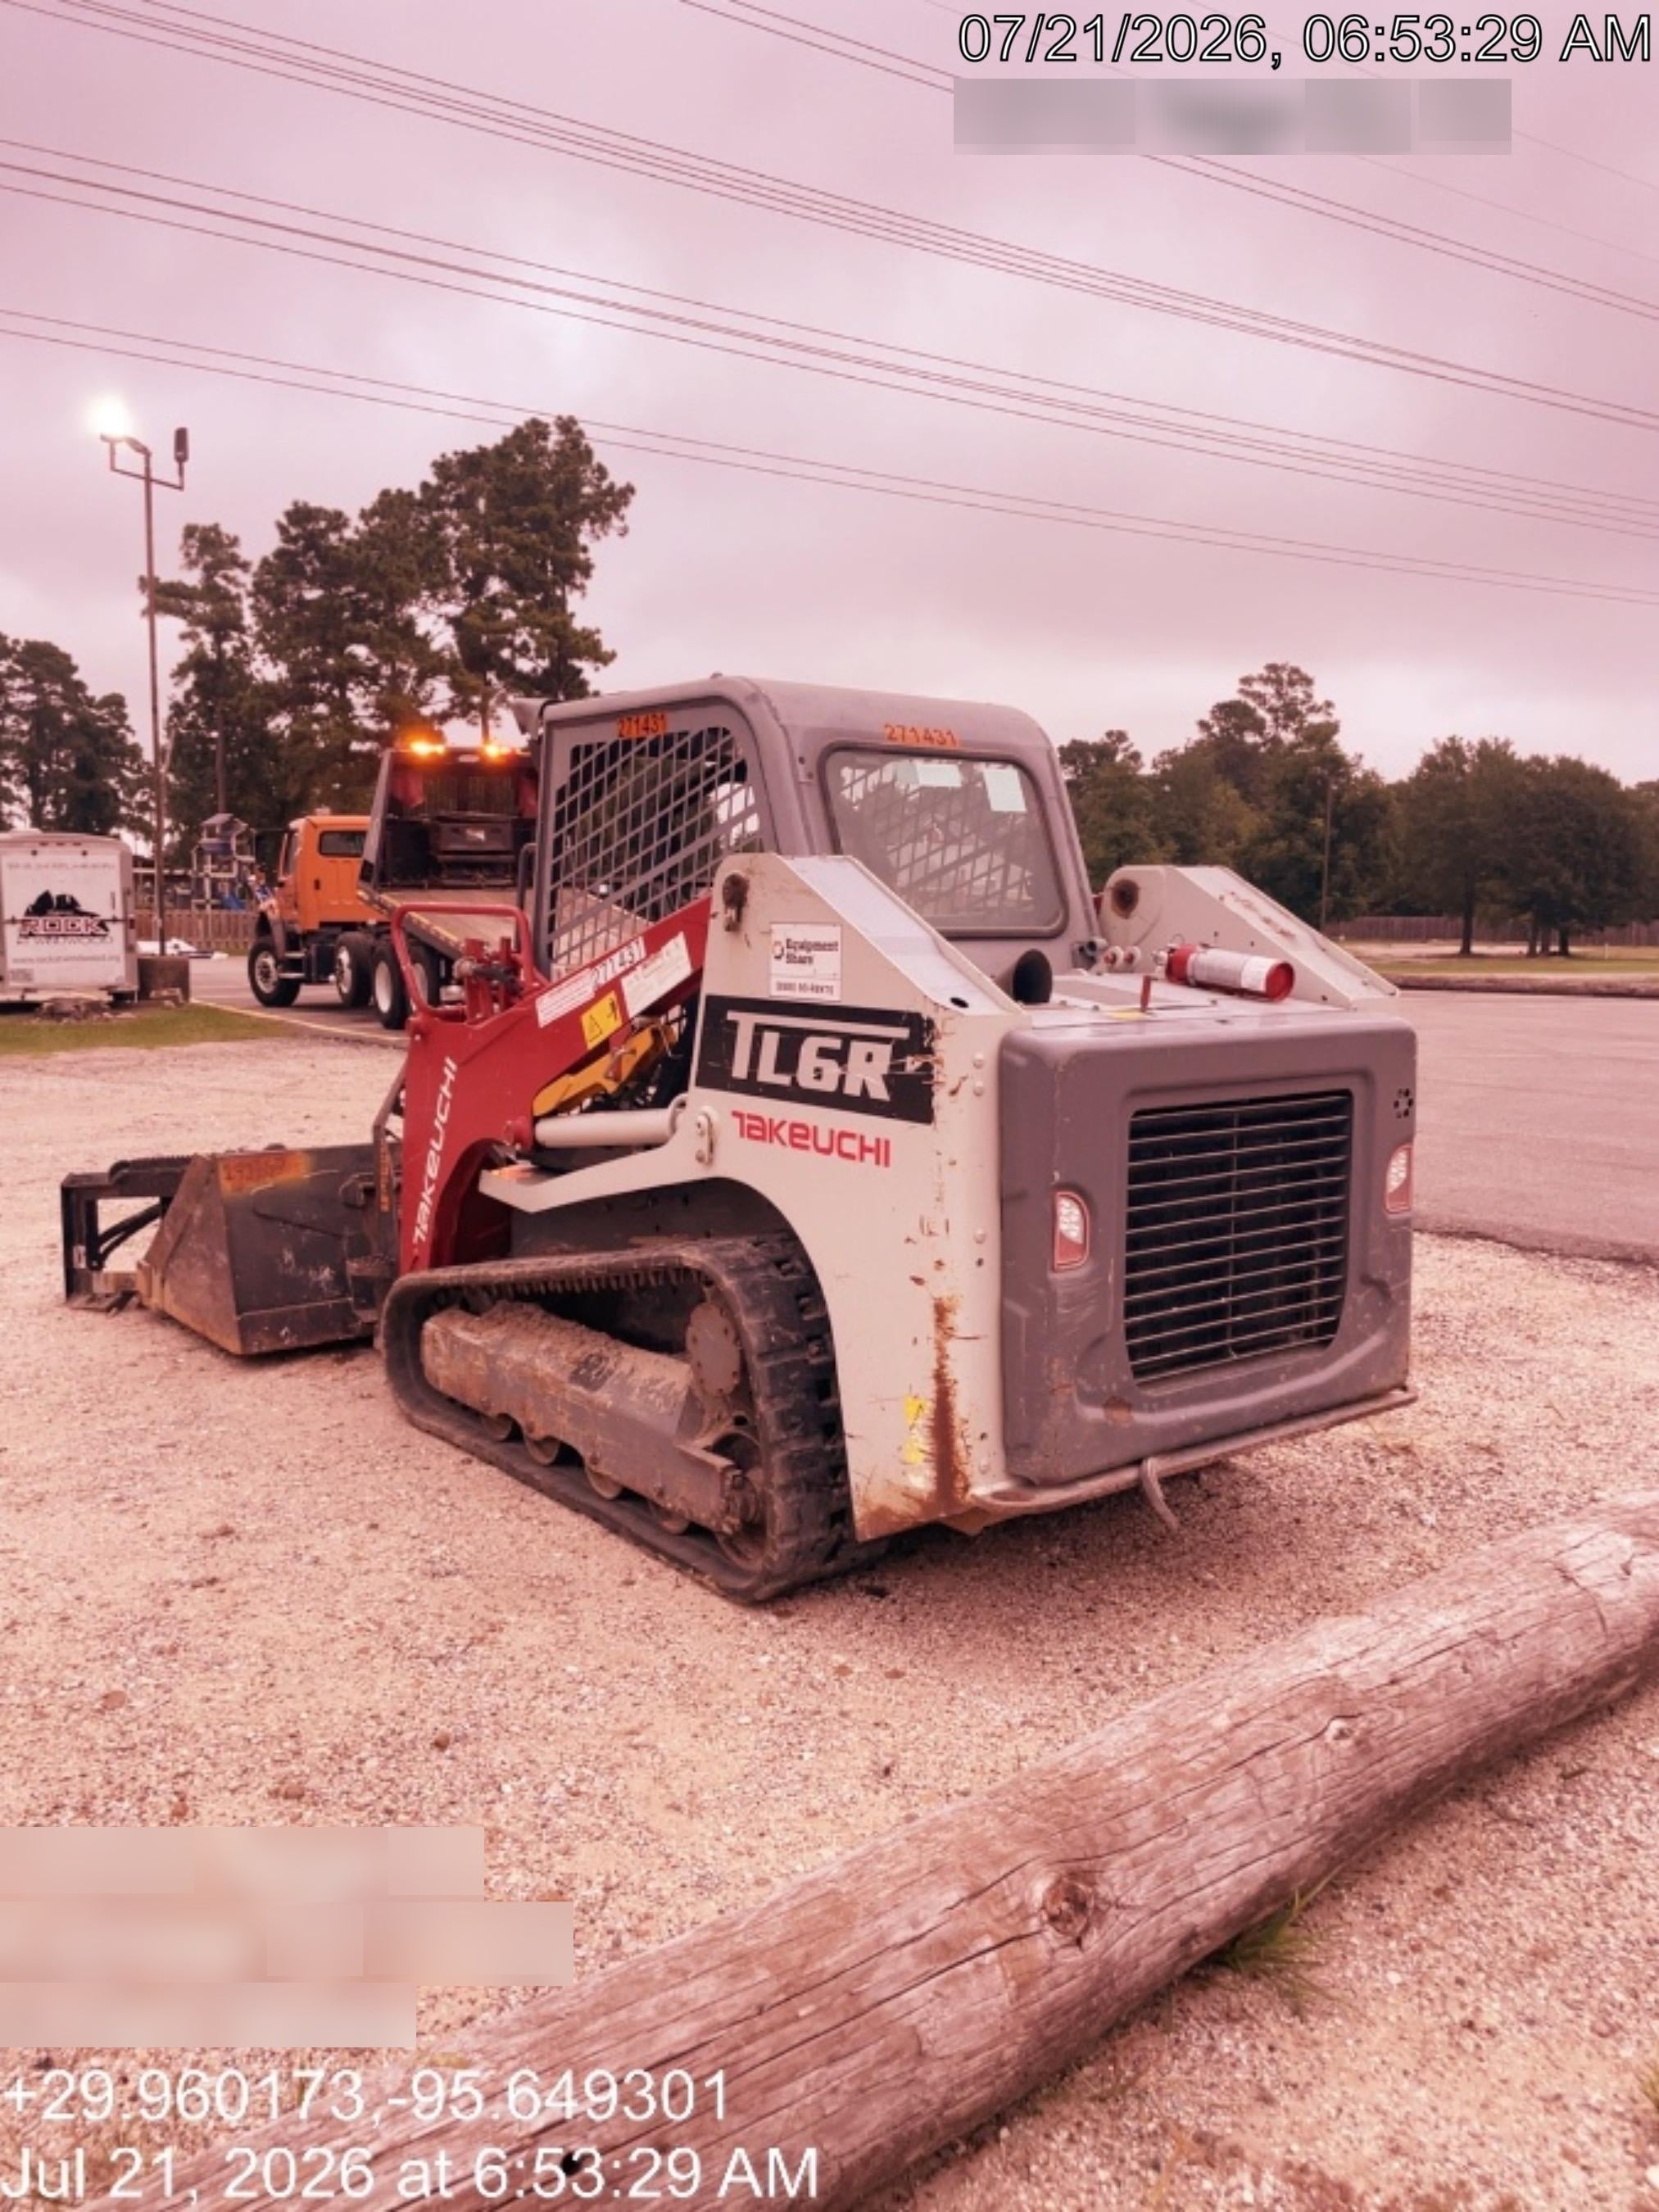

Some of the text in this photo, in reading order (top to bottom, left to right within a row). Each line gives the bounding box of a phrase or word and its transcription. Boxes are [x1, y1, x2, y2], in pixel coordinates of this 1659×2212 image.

[884, 723, 958, 748] 271431
[20, 918, 100, 933] ROCK
[726, 1009, 910, 1102] TL6R
